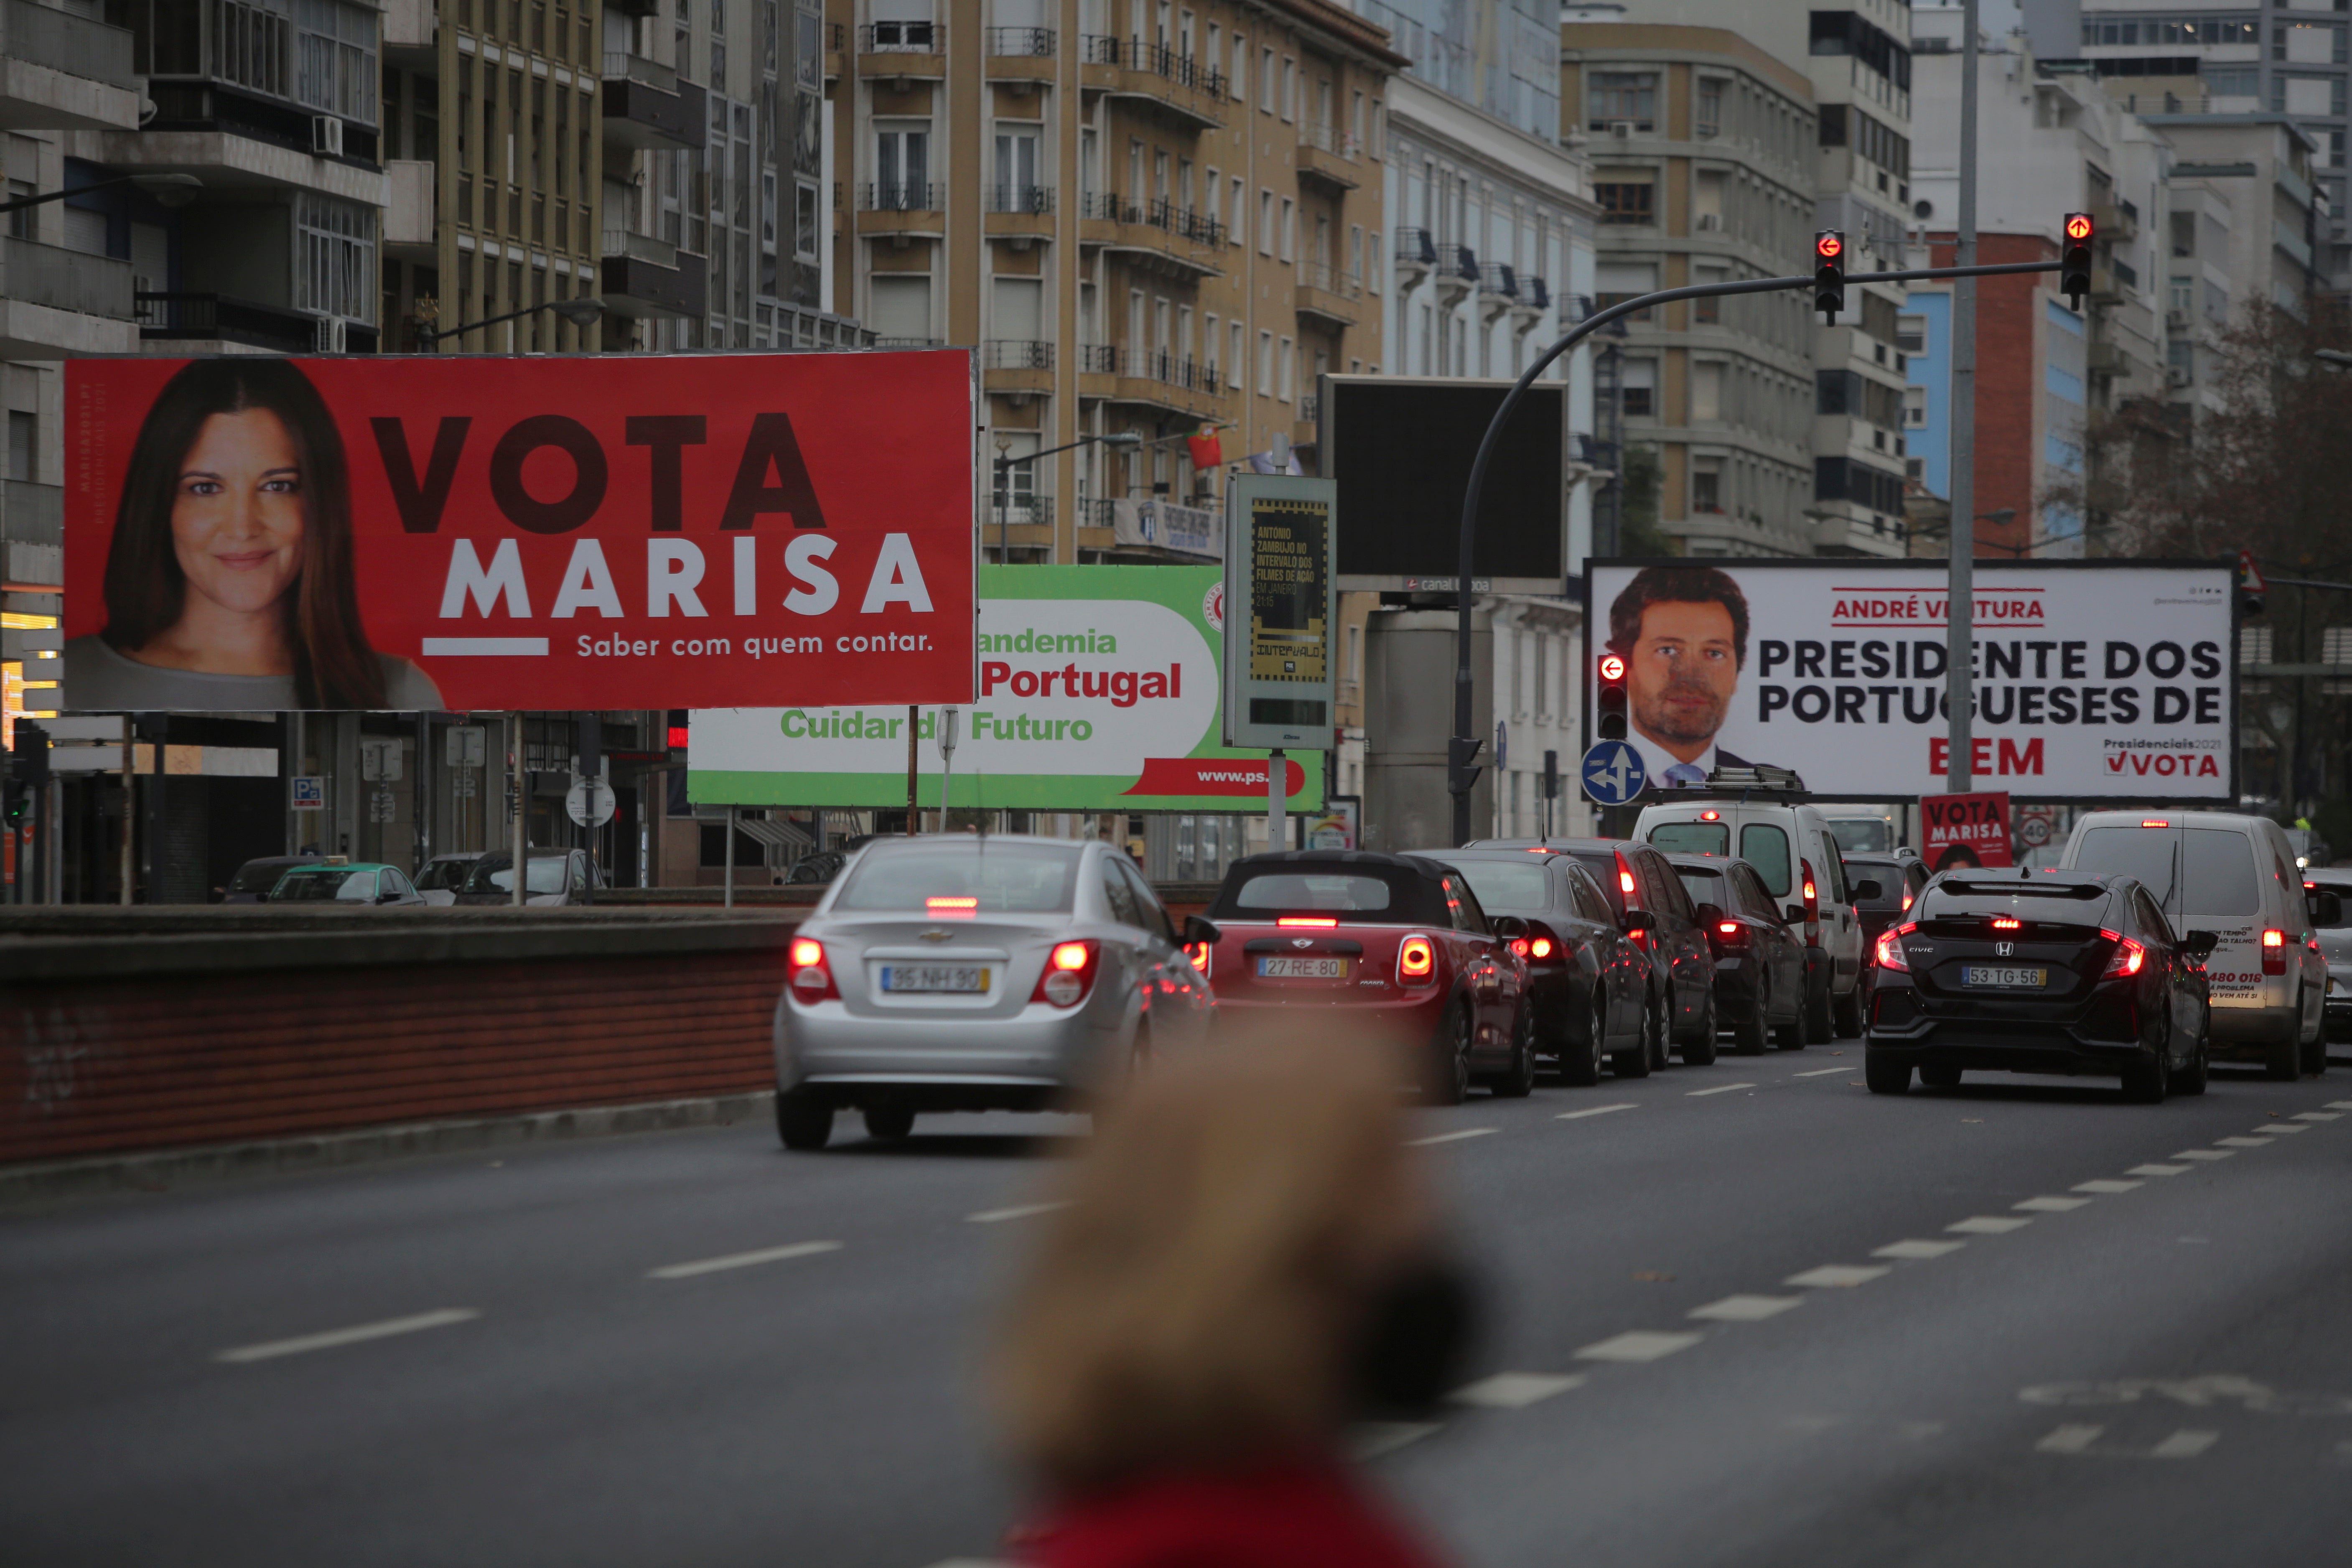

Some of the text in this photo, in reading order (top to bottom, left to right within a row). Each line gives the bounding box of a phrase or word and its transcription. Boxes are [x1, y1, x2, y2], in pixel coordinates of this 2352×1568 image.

[79, 383, 91, 493] MARISA2021.PT
[94, 383, 105, 524] PRESIDENCIAIS 2021
[369, 412, 827, 534] VOTA
[1257, 526, 1291, 539] ANTÓNIO
[1257, 540, 1307, 554] ZAMBUJO NO
[1257, 554, 1312, 568] INTERVALO DOS
[439, 533, 934, 618] MARISA
[1256, 568, 1314, 583] FILMES DE AÇÃO
[1422, 578, 1453, 591] canal
[1256, 582, 1297, 595] EM JANEIRO
[1257, 596, 1274, 607] 21:15
[1832, 596, 1919, 618] ANDRÉ
[577, 632, 933, 659] Saber com quem contar.
[979, 629, 1116, 654] andemia
[2105, 641, 2221, 679] DOS
[981, 662, 1181, 708] Portugal
[2153, 687, 2221, 724] DE
[781, 710, 903, 739] Cuidar
[972, 712, 1092, 741] Futuro
[2131, 754, 2219, 777] VOTA
[1928, 801, 2001, 825] VOTA
[1931, 823, 2003, 842] MARISA
[2209, 972, 2262, 983] 480 018
